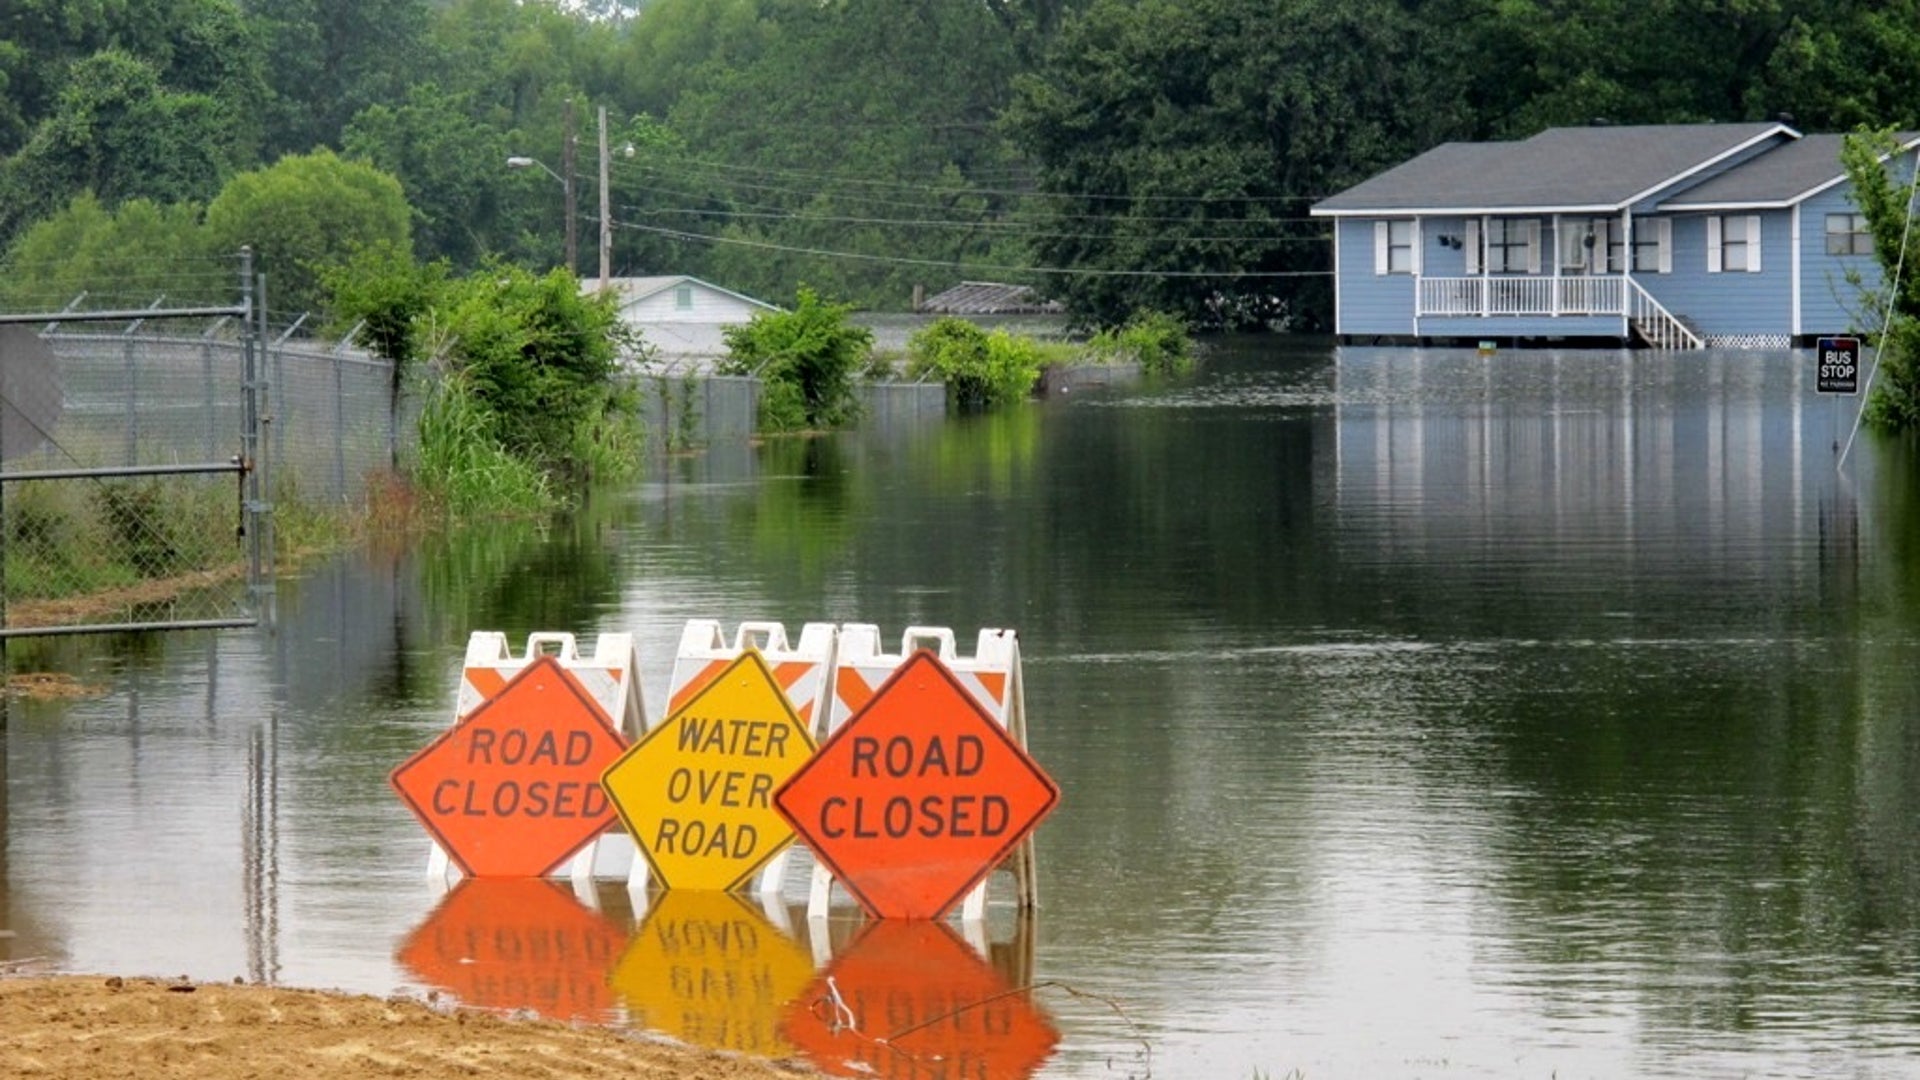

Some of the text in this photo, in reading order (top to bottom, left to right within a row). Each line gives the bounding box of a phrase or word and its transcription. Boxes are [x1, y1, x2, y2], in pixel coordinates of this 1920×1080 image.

[1820, 365, 1855, 378] STOP
[1825, 350, 1852, 364] BUS
[467, 729, 593, 765] ROAD
[677, 717, 790, 758] WATER
[851, 735, 984, 778] ROAD
[432, 779, 609, 818] CLOSED
[667, 768, 773, 809] OVER
[820, 796, 1010, 839] CLOSED
[655, 819, 758, 859] ROAD
